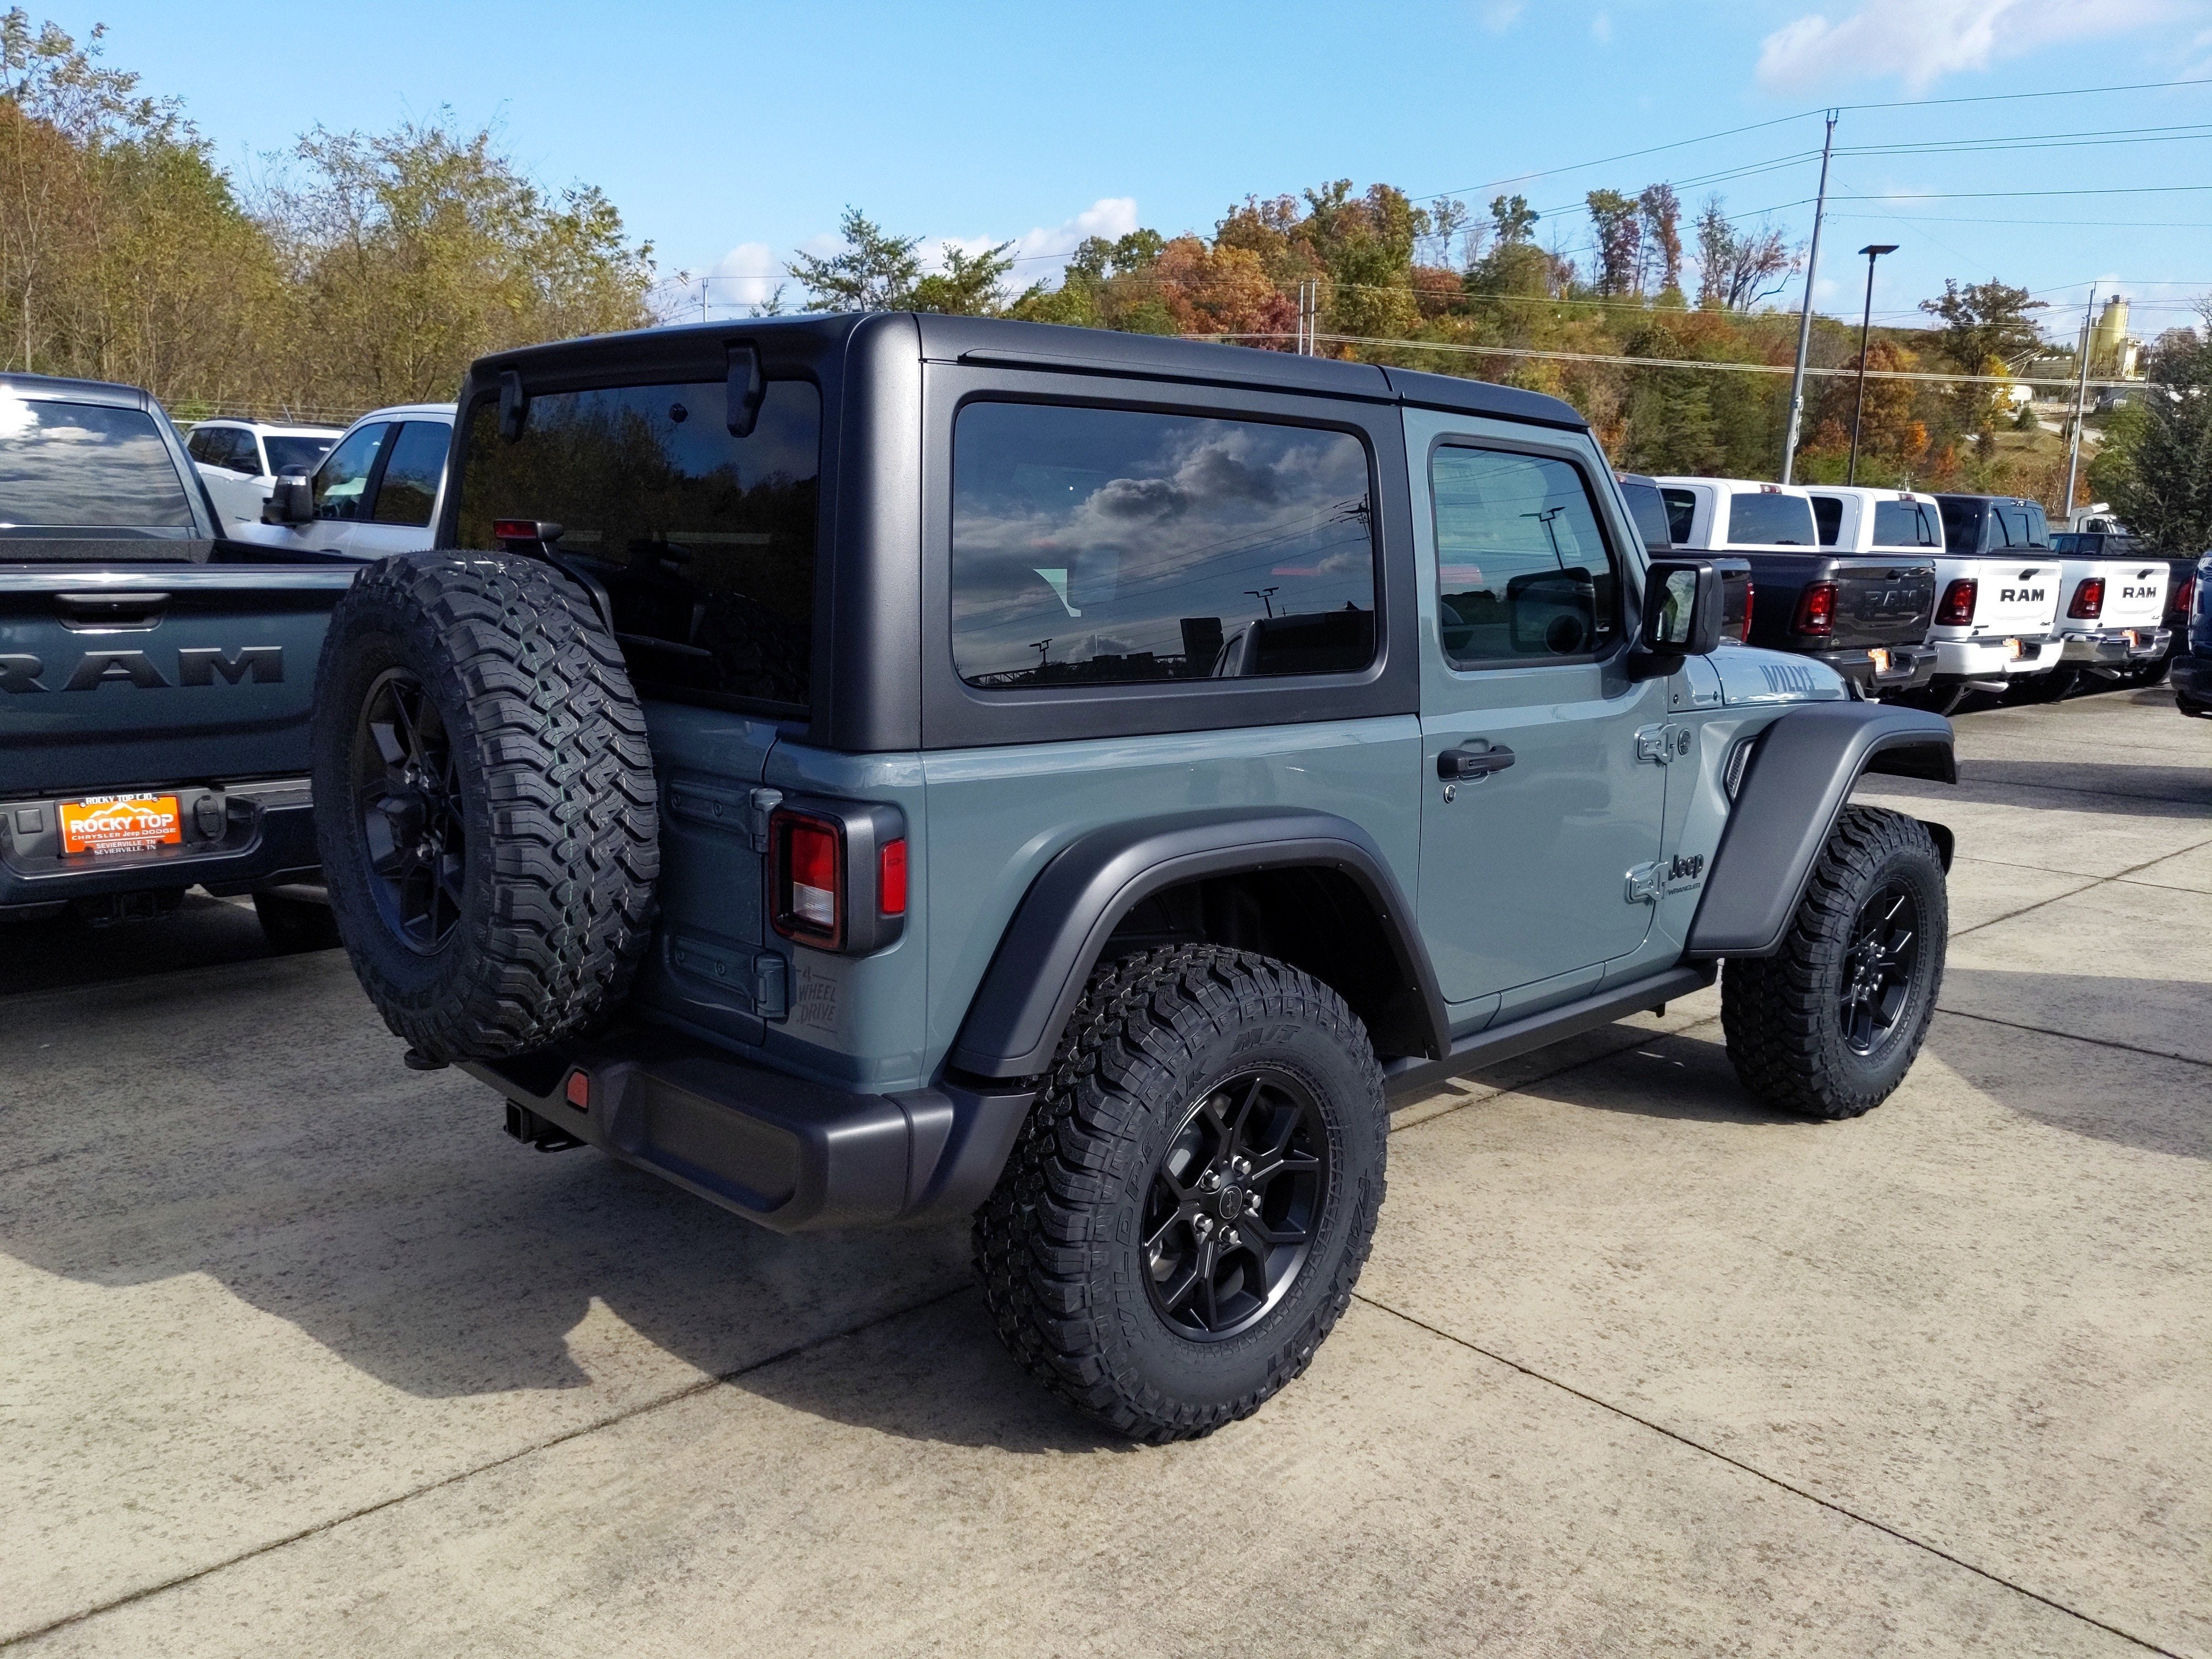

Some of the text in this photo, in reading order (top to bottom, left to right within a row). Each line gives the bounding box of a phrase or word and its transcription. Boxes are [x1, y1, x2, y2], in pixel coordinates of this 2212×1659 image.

[1863, 590, 1918, 607] RAM
[2000, 589, 2045, 602] RAM
[2121, 587, 2157, 598] RAM
[1758, 665, 1815, 692] WILLYS
[86, 795, 115, 805] ROCKY
[117, 794, 134, 803] TOP
[70, 814, 174, 833] ROCKY TOP
[71, 832, 121, 840] CHRYSLER
[1668, 854, 1704, 881] Jeep
[1667, 883, 1701, 895] WRANGLER
[802, 966, 811, 981] 4
[798, 983, 836, 1002] WHEEL
[797, 1003, 836, 1024] DRIVE
[1229, 1024, 1301, 1056] M/T
